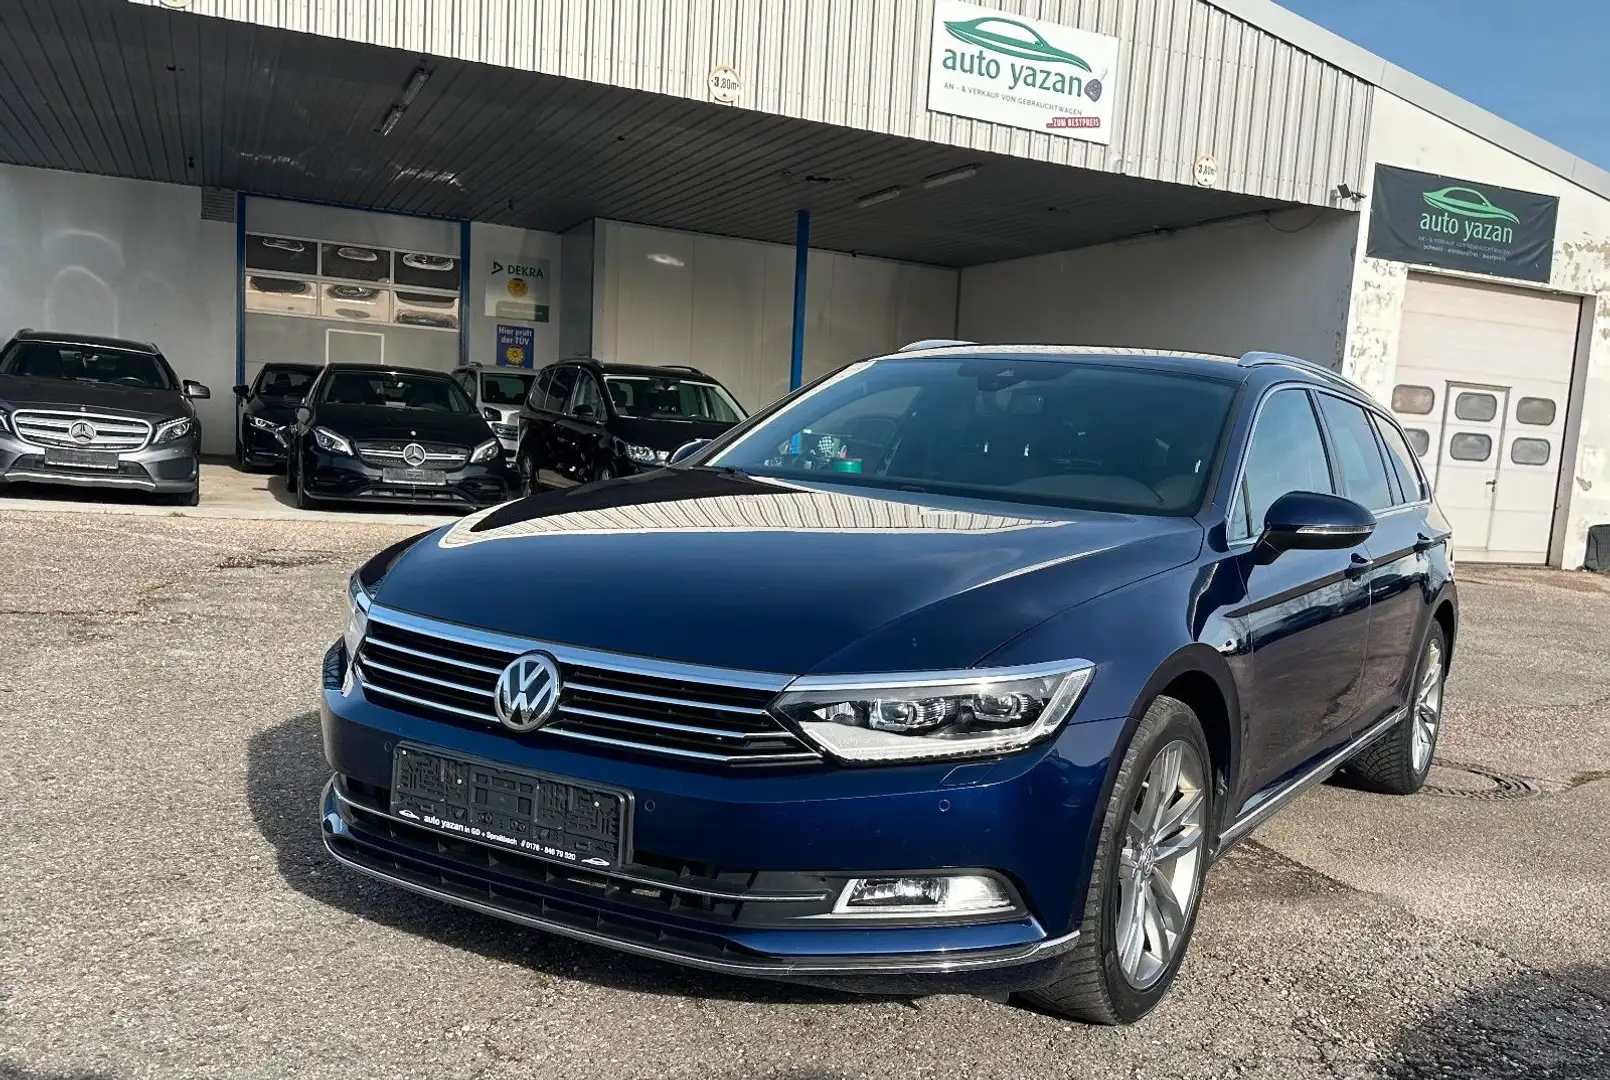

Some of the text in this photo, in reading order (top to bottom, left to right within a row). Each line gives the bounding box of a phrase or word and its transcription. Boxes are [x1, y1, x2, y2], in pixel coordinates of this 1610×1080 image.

[942, 48, 1082, 98] auto yazan
[944, 82, 955, 90] AN
[968, 87, 1000, 100] VERKAUF
[1001, 94, 1017, 103] VON
[1018, 97, 1082, 116] GEBRAUCHTWAGEN
[1067, 118, 1099, 127] BESTPREIS
[1420, 212, 1513, 243] auto yazan
[507, 264, 544, 279] DEKRA
[498, 326, 514, 336] Hier
[501, 335, 513, 345] der
[423, 815, 440, 826] auto
[441, 819, 464, 832] yazan
[464, 825, 470, 833] in
